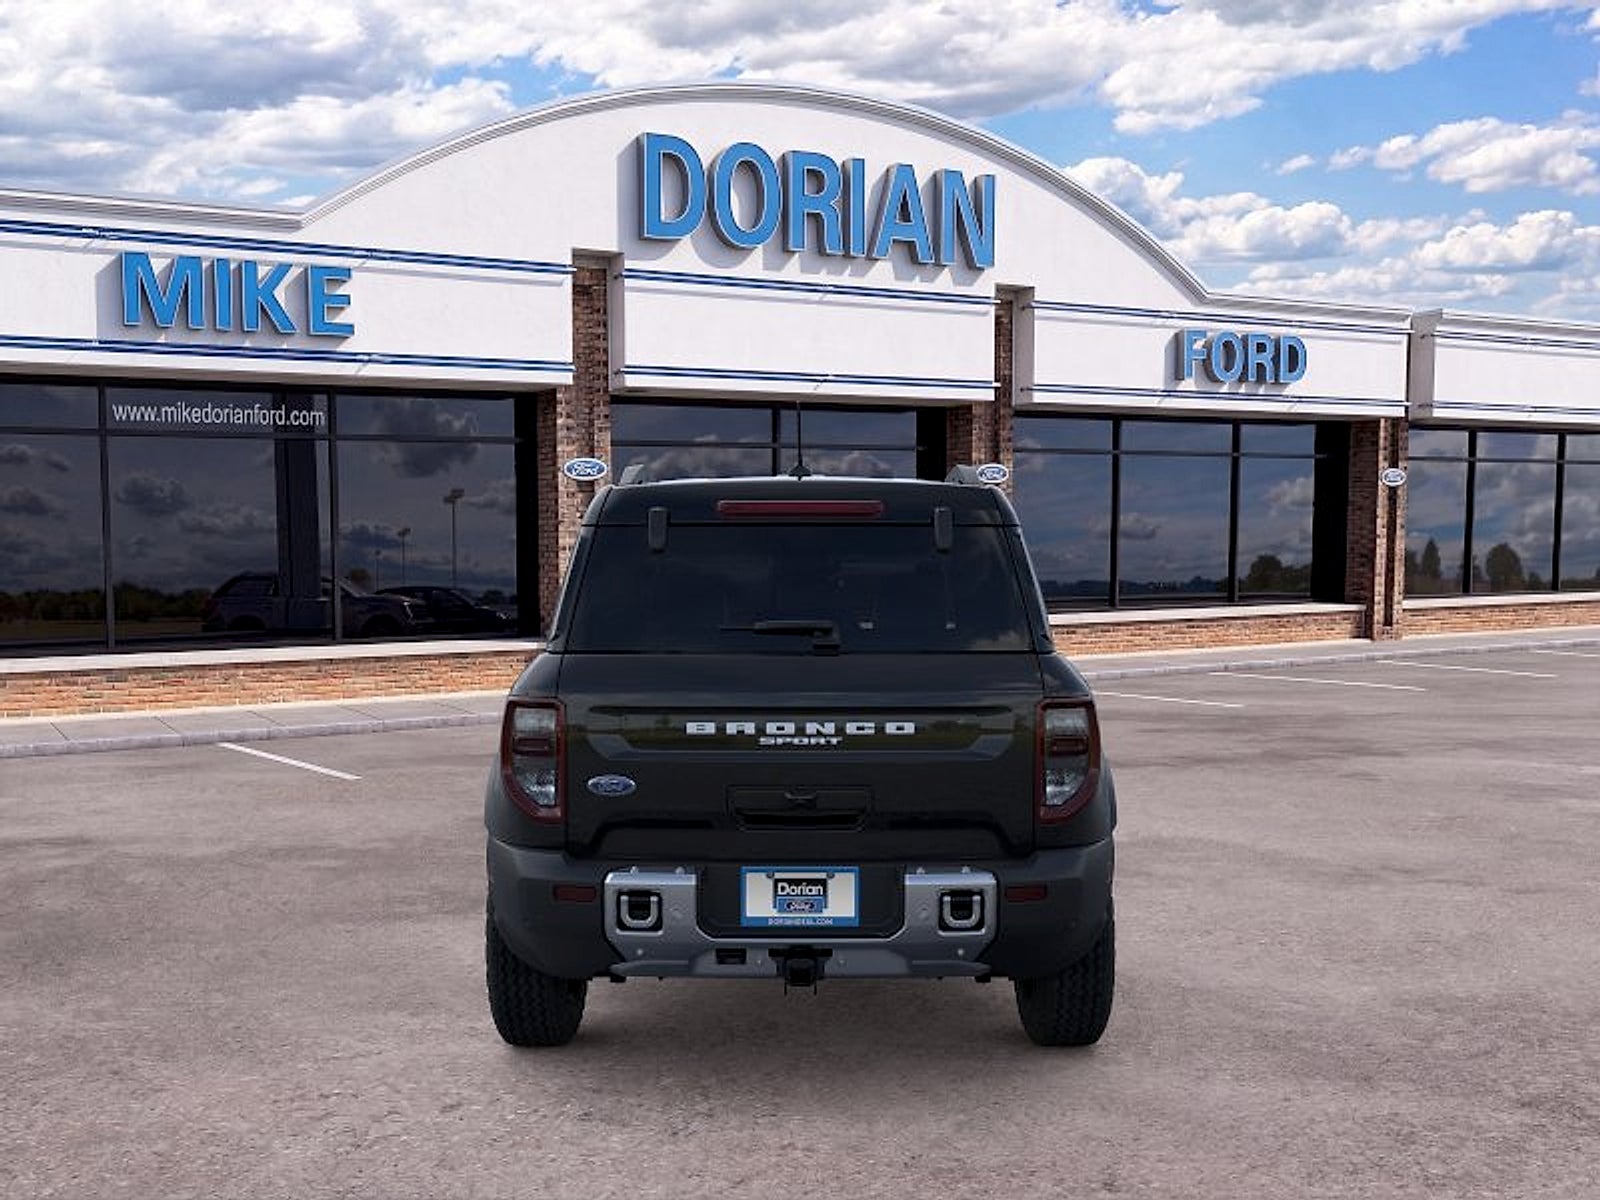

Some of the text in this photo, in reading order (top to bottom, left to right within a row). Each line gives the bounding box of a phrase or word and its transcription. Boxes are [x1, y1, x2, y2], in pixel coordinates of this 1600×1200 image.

[639, 132, 996, 270] DORIAN
[121, 251, 355, 336] MIKE
[1176, 328, 1308, 384] FORD
[112, 401, 325, 427] www.mikedorianford.com
[686, 721, 916, 736] BRONCO
[758, 736, 843, 746] SPORT
[777, 881, 824, 896] Dorian
